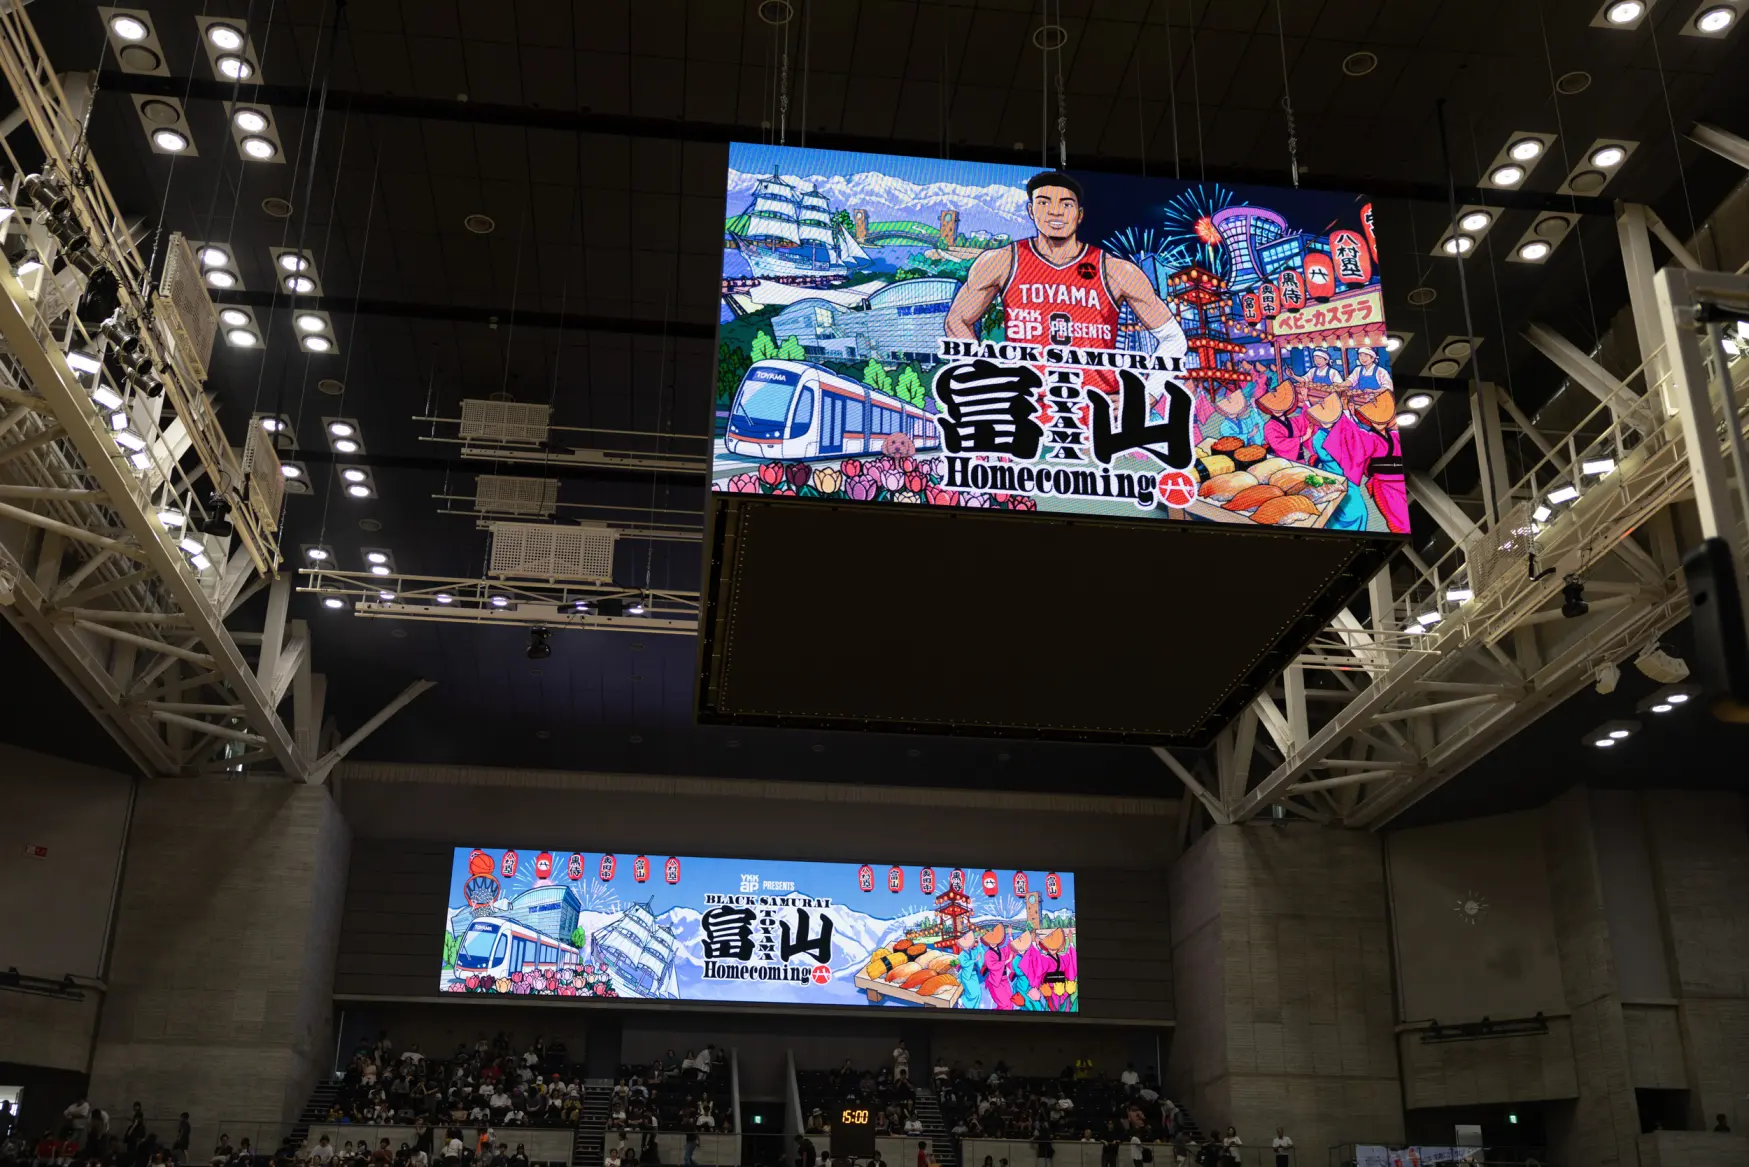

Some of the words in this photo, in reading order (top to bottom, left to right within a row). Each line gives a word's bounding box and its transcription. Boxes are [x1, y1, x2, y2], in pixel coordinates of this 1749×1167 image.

[1334, 233, 1364, 278] 八村塁
[1019, 283, 1100, 310] TOYAMA
[1261, 284, 1277, 314] 奥田中
[1281, 271, 1302, 305] 黒侍
[1007, 308, 1042, 321] YKK
[1278, 300, 1373, 331] ベビーカステラ
[1050, 320, 1112, 340] PRESENTS
[942, 340, 1040, 362] BLACK
[1046, 348, 1185, 372] SAMURAI
[756, 371, 787, 382] TOYAMA
[936, 359, 1193, 470] 富山
[1048, 370, 1085, 461] TOYAMA
[943, 456, 1157, 508] Homecoming
[740, 874, 759, 882] YKK
[763, 880, 795, 891] PRESENTS
[706, 894, 756, 906] BLACK
[759, 896, 831, 908] SAMURAI
[701, 905, 833, 964] 富山
[758, 909, 777, 960] TOYAMA
[703, 960, 812, 985] Homecoming
[842, 1110, 869, 1124] 15:00
